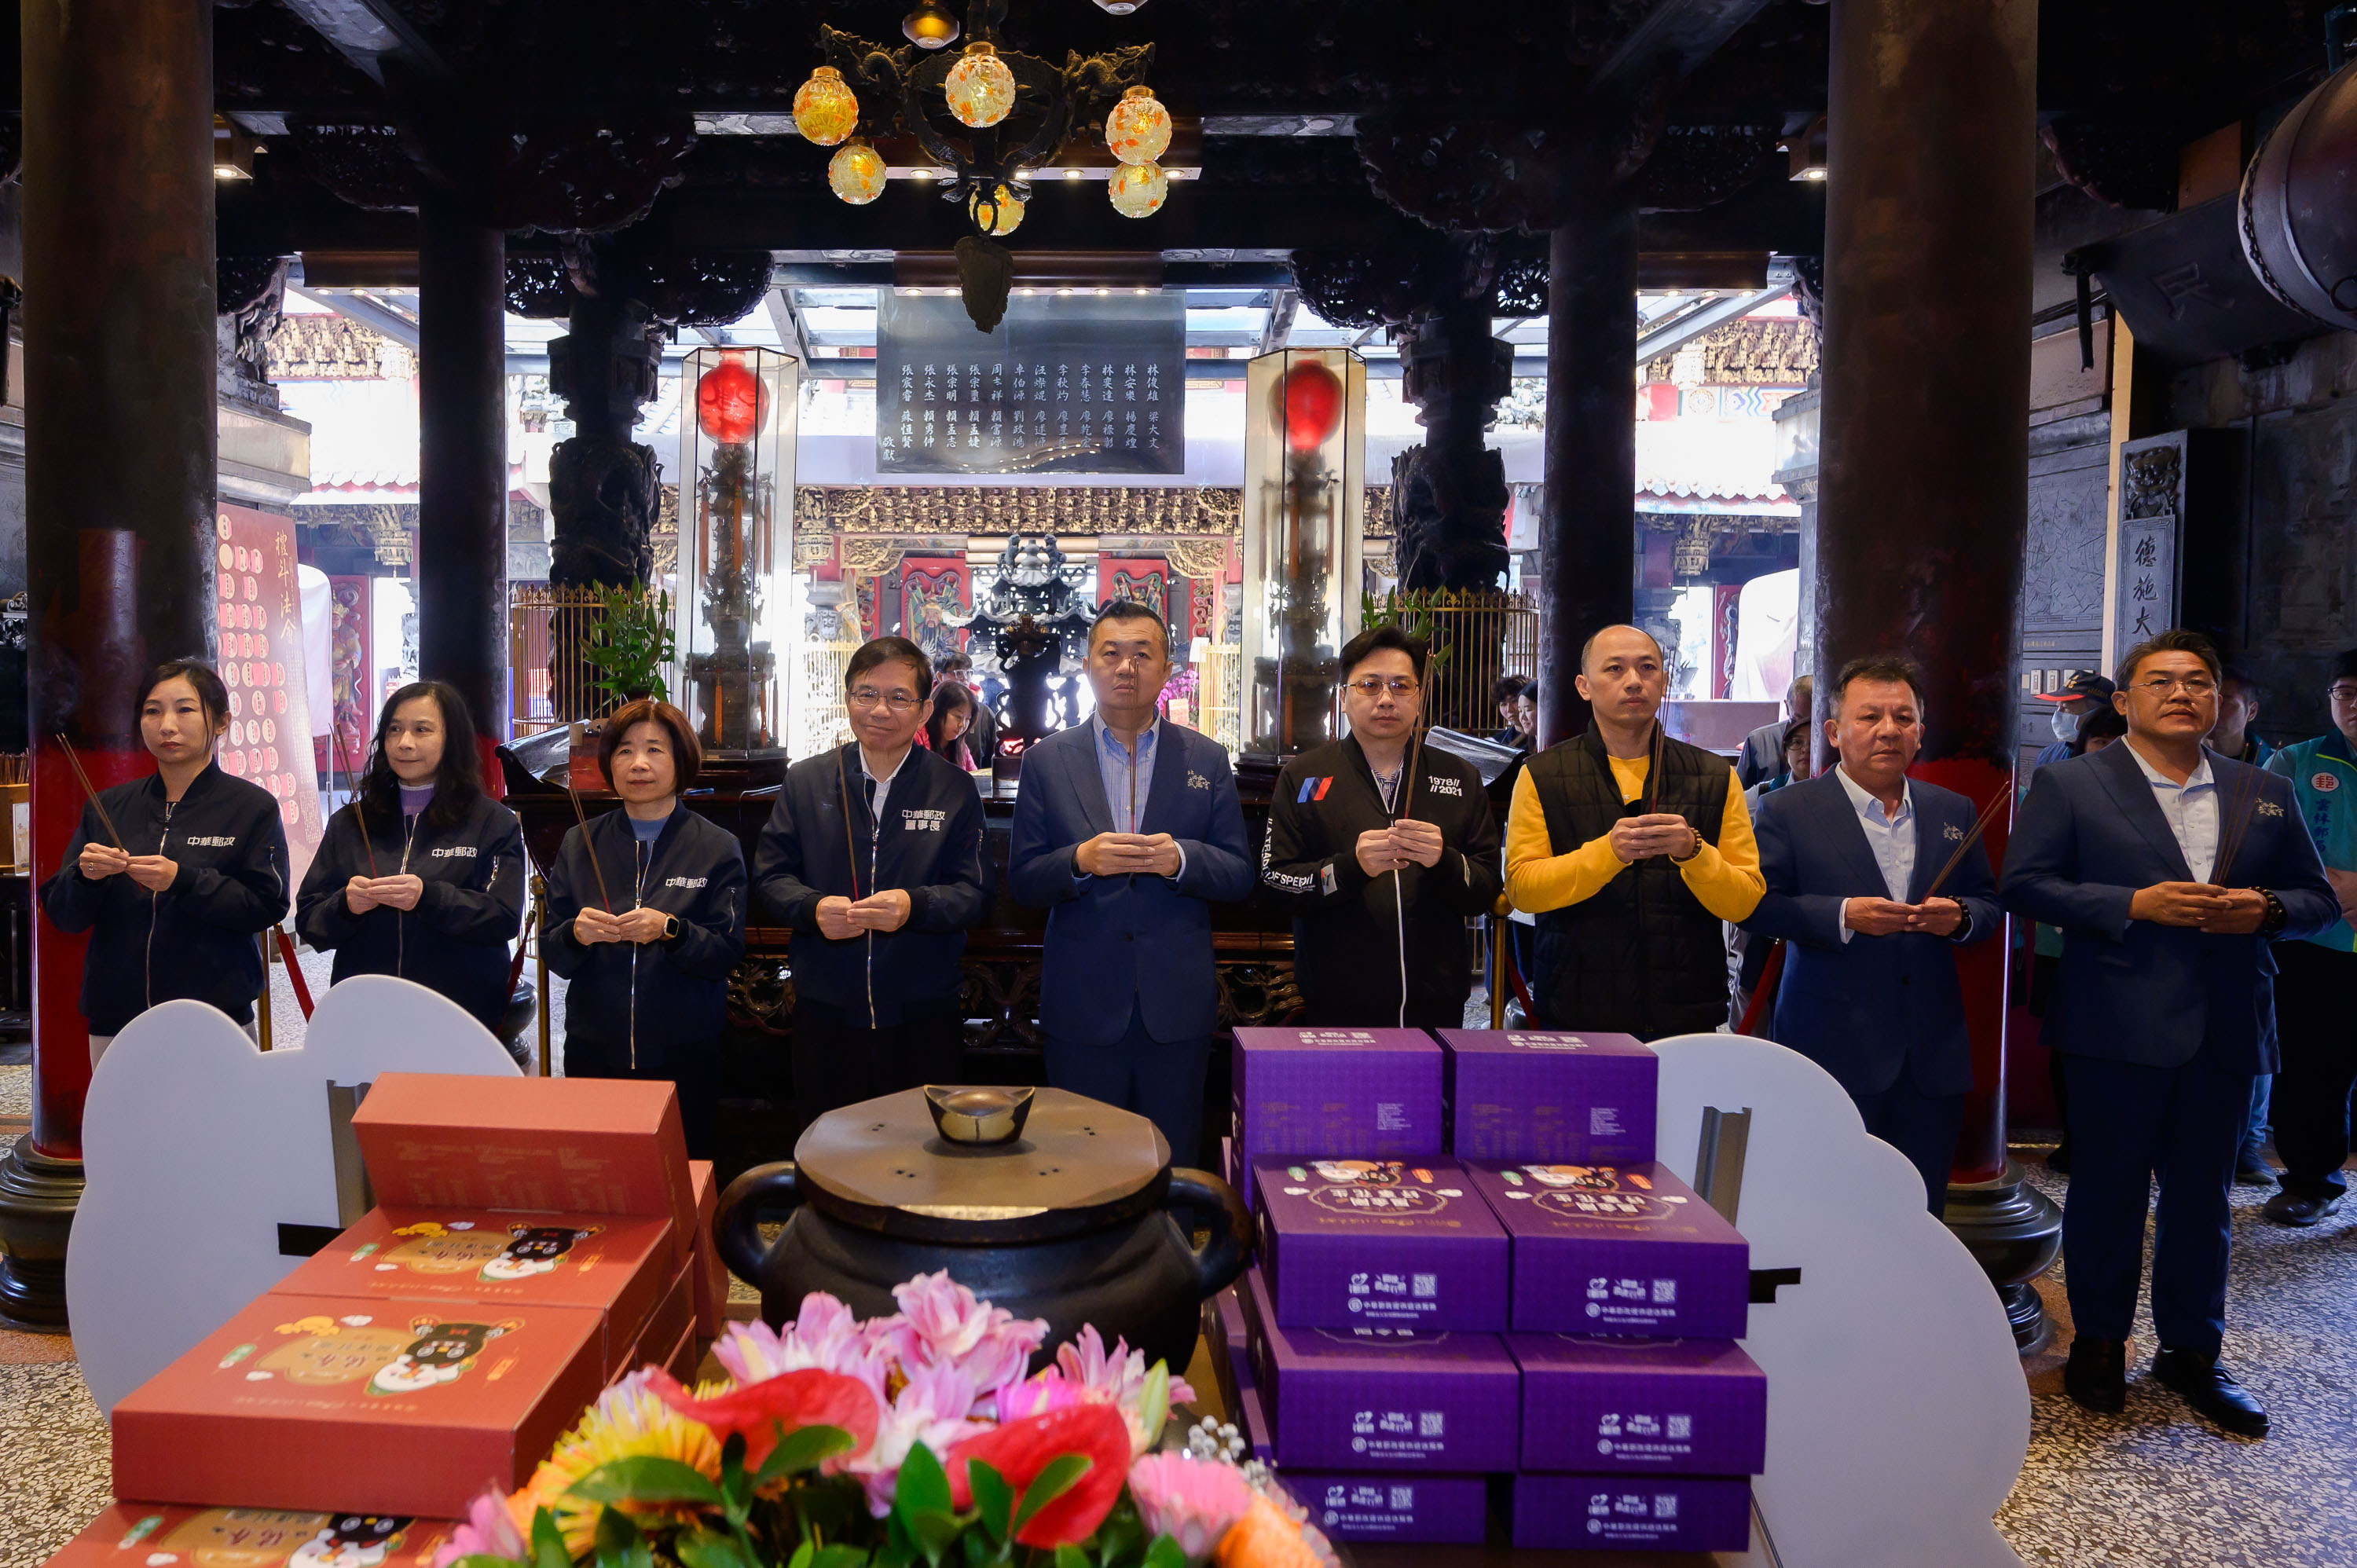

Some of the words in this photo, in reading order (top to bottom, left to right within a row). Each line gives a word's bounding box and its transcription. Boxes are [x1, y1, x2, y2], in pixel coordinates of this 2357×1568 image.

[924, 364, 937, 401] 張永杰
[946, 364, 959, 401] 張宗明
[991, 364, 1003, 401] 周吉祥
[1013, 364, 1026, 401] 卓伯源
[1146, 364, 1160, 401] 林俊雄
[945, 410, 958, 449] 賴孟志
[275, 529, 296, 645] 禮斗法會
[901, 809, 945, 821] 中華郵政
[905, 819, 940, 831] 董事長
[187, 836, 236, 847] 中華郵政
[431, 846, 478, 858] 中華郵政
[665, 876, 708, 888] 中華郵政
